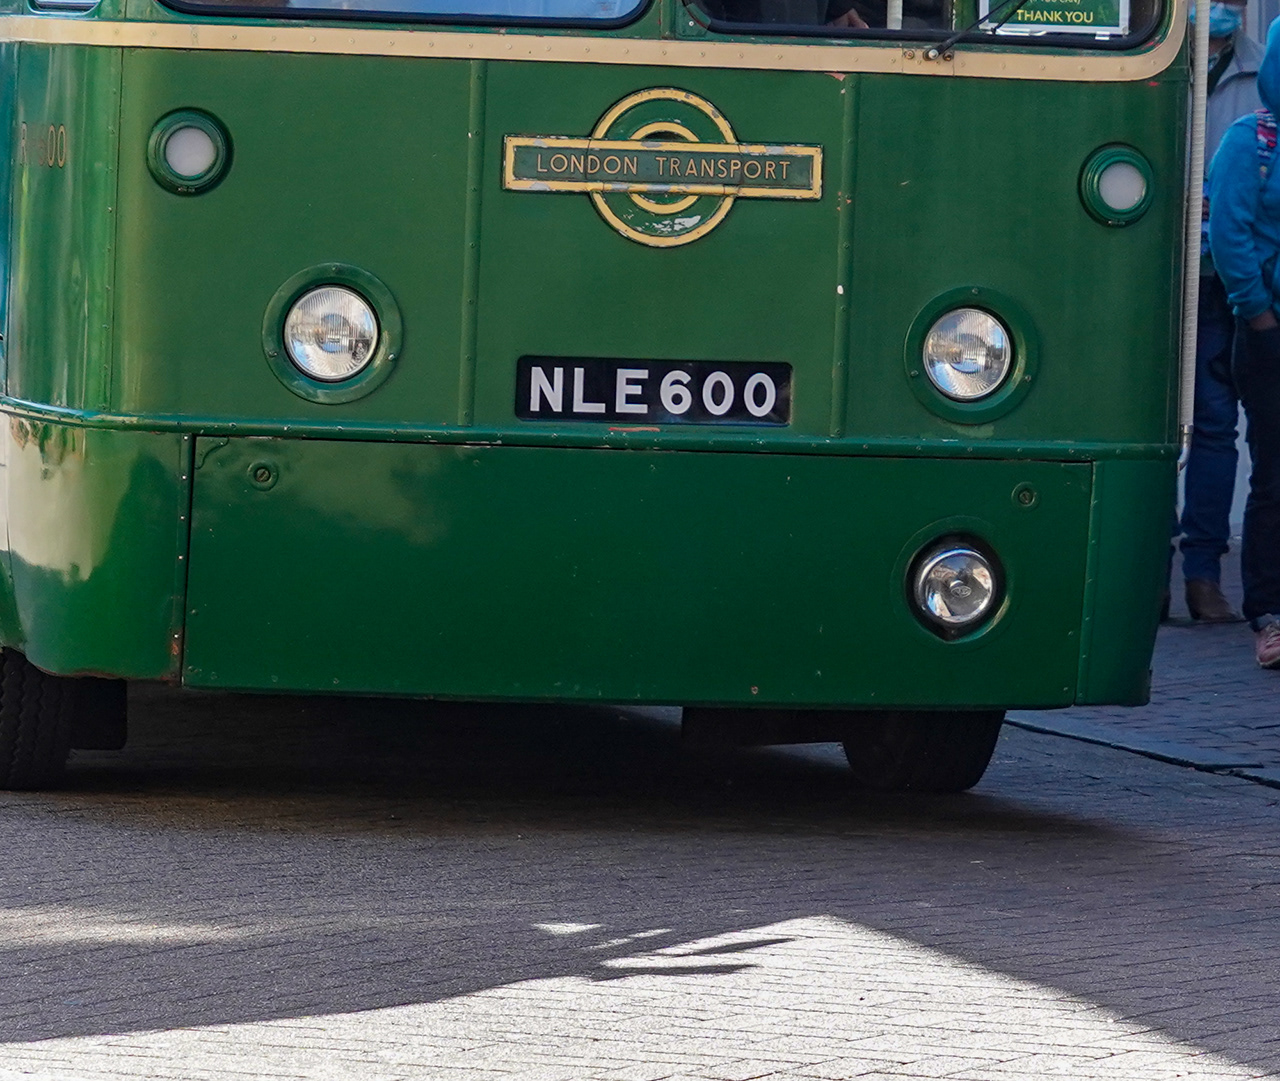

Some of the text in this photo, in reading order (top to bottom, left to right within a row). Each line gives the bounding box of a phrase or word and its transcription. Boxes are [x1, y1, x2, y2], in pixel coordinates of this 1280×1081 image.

[1016, 9, 1093, 23] THANK YOU
[537, 153, 791, 180] LONDON TRANSPORT
[529, 366, 776, 418] NLE600
